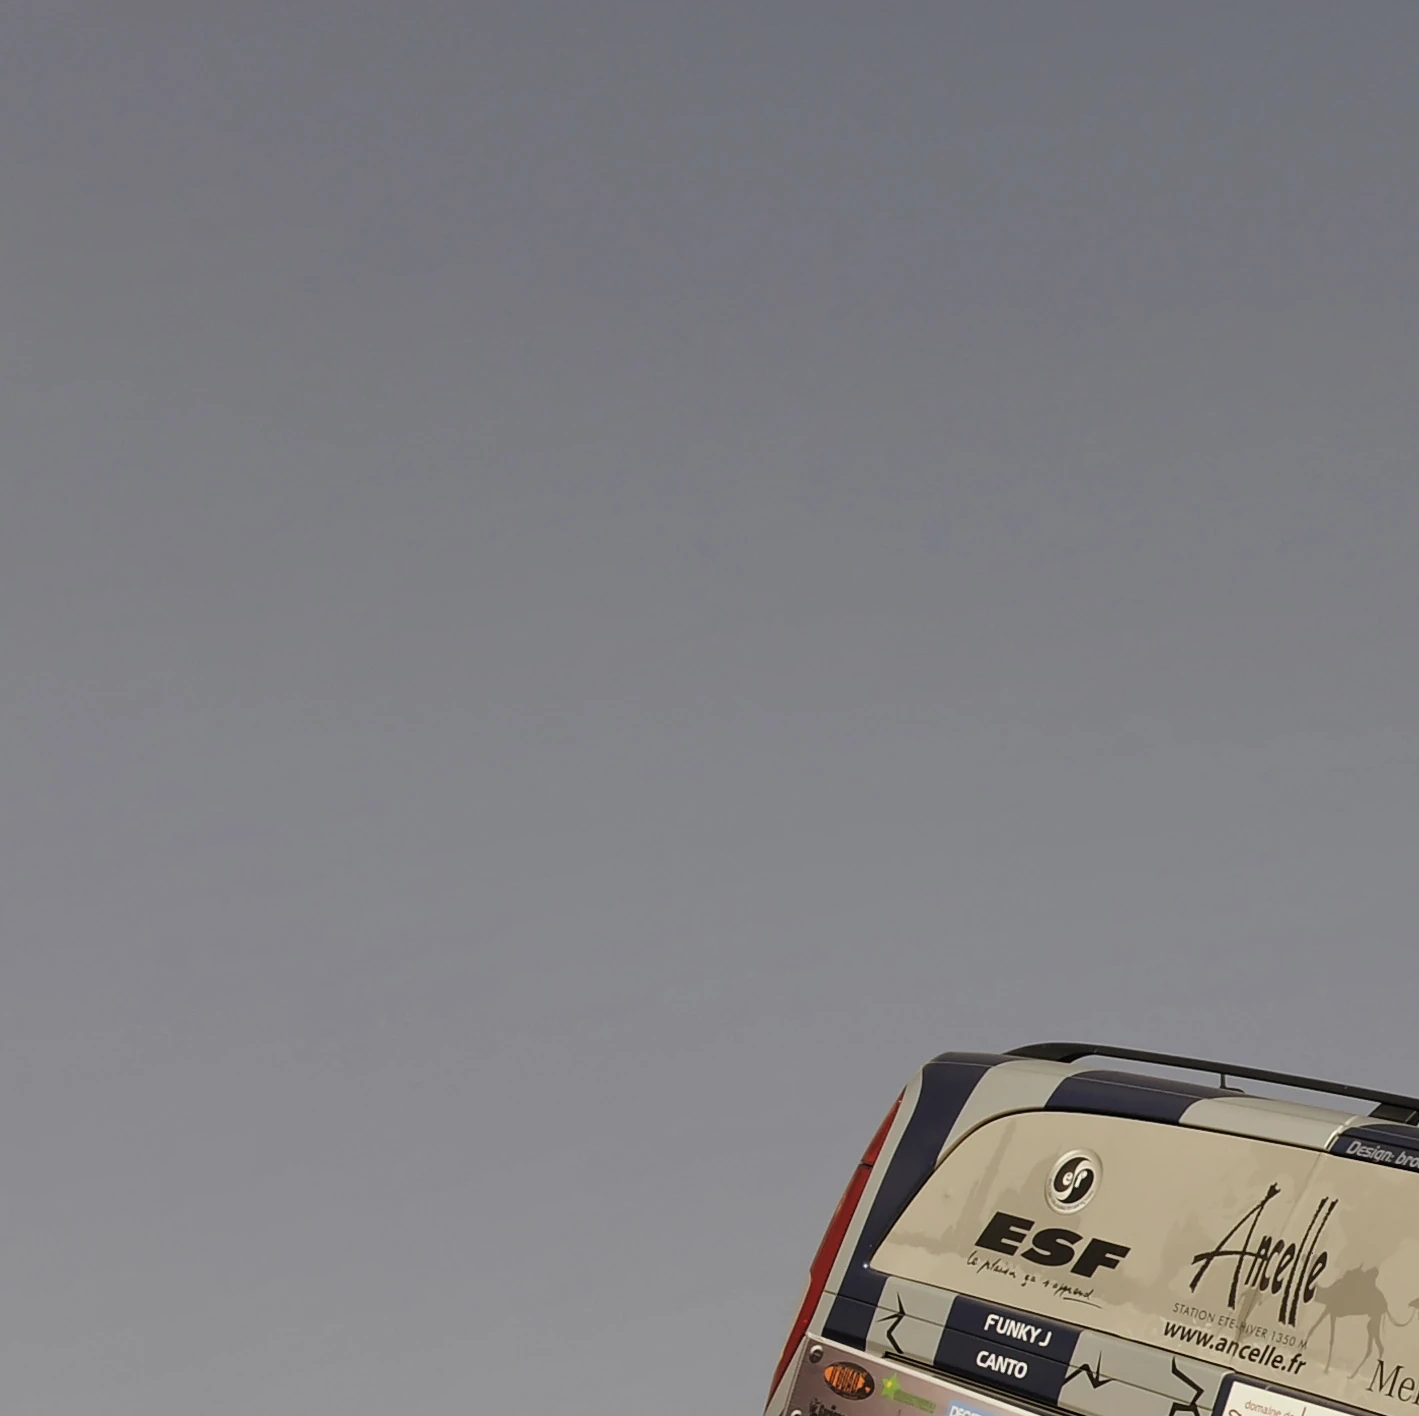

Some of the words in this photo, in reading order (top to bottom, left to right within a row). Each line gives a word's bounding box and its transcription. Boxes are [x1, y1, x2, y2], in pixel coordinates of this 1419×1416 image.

[1346, 1140, 1394, 1162] Design:
[974, 1211, 1132, 1279] ESF
[1190, 1182, 1339, 1327] Ancelle
[983, 1313, 1042, 1344] FUNKY
[1164, 1320, 1307, 1376] www.ancelle.fr
[1172, 1302, 1215, 1323] STATION
[1217, 1315, 1269, 1339] ETE-HIVER
[1270, 1331, 1296, 1348] 1350
[975, 1350, 1029, 1380] CANTO
